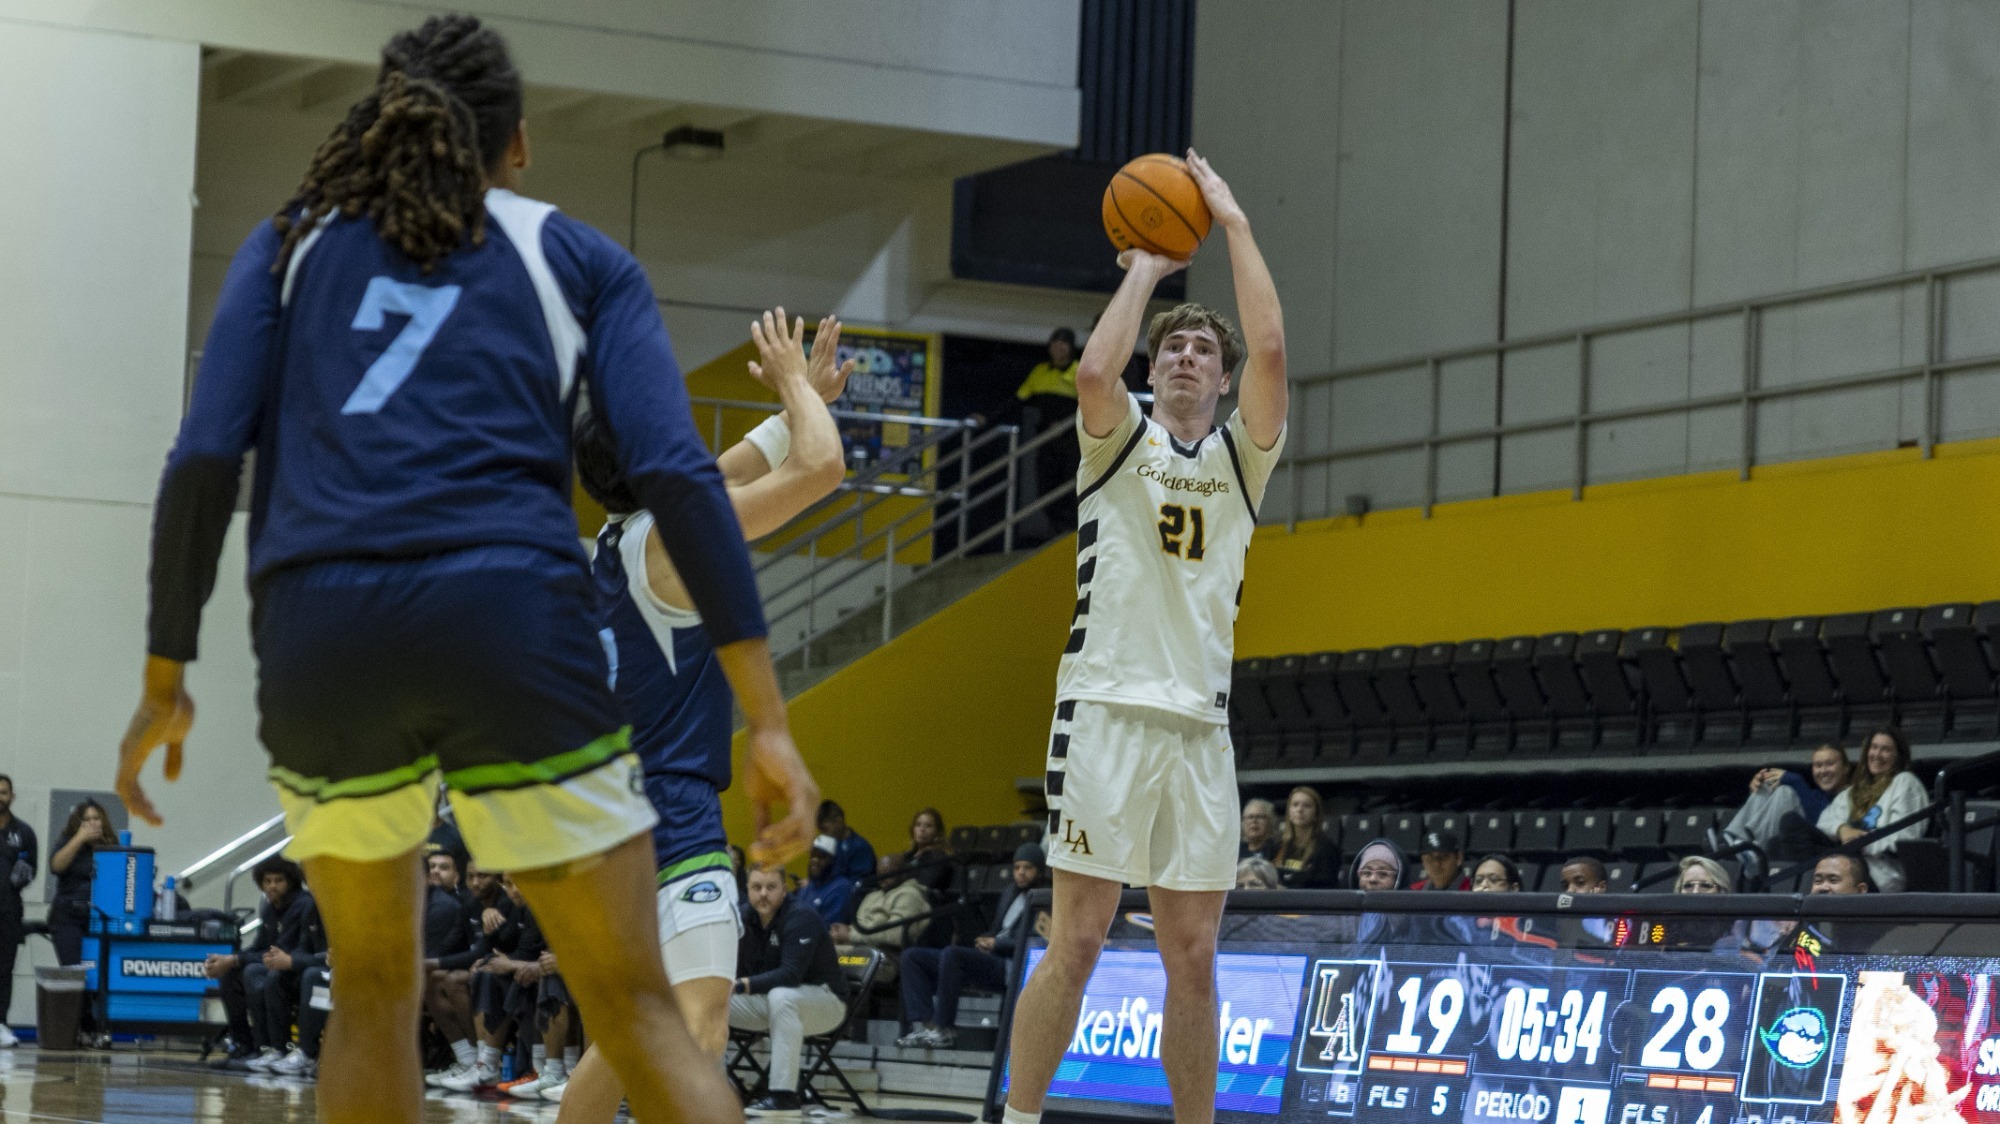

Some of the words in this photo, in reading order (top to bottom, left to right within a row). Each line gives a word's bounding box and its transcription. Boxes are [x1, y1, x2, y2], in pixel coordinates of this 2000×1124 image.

[340, 275, 463, 415] 7
[1158, 502, 1205, 562] 21
[1063, 819, 1094, 856] LA
[123, 959, 206, 977] POWERAD
[1386, 977, 1464, 1054] 19
[1497, 987, 1608, 1065] 05:34
[1641, 986, 1730, 1070] 28
[1367, 1085, 1409, 1109] FLS
[1431, 1086, 1449, 1116] 5
[1474, 1091, 1550, 1121] PERIOD
[1574, 1097, 1585, 1124] 1
[1620, 1103, 1669, 1124] FLS
